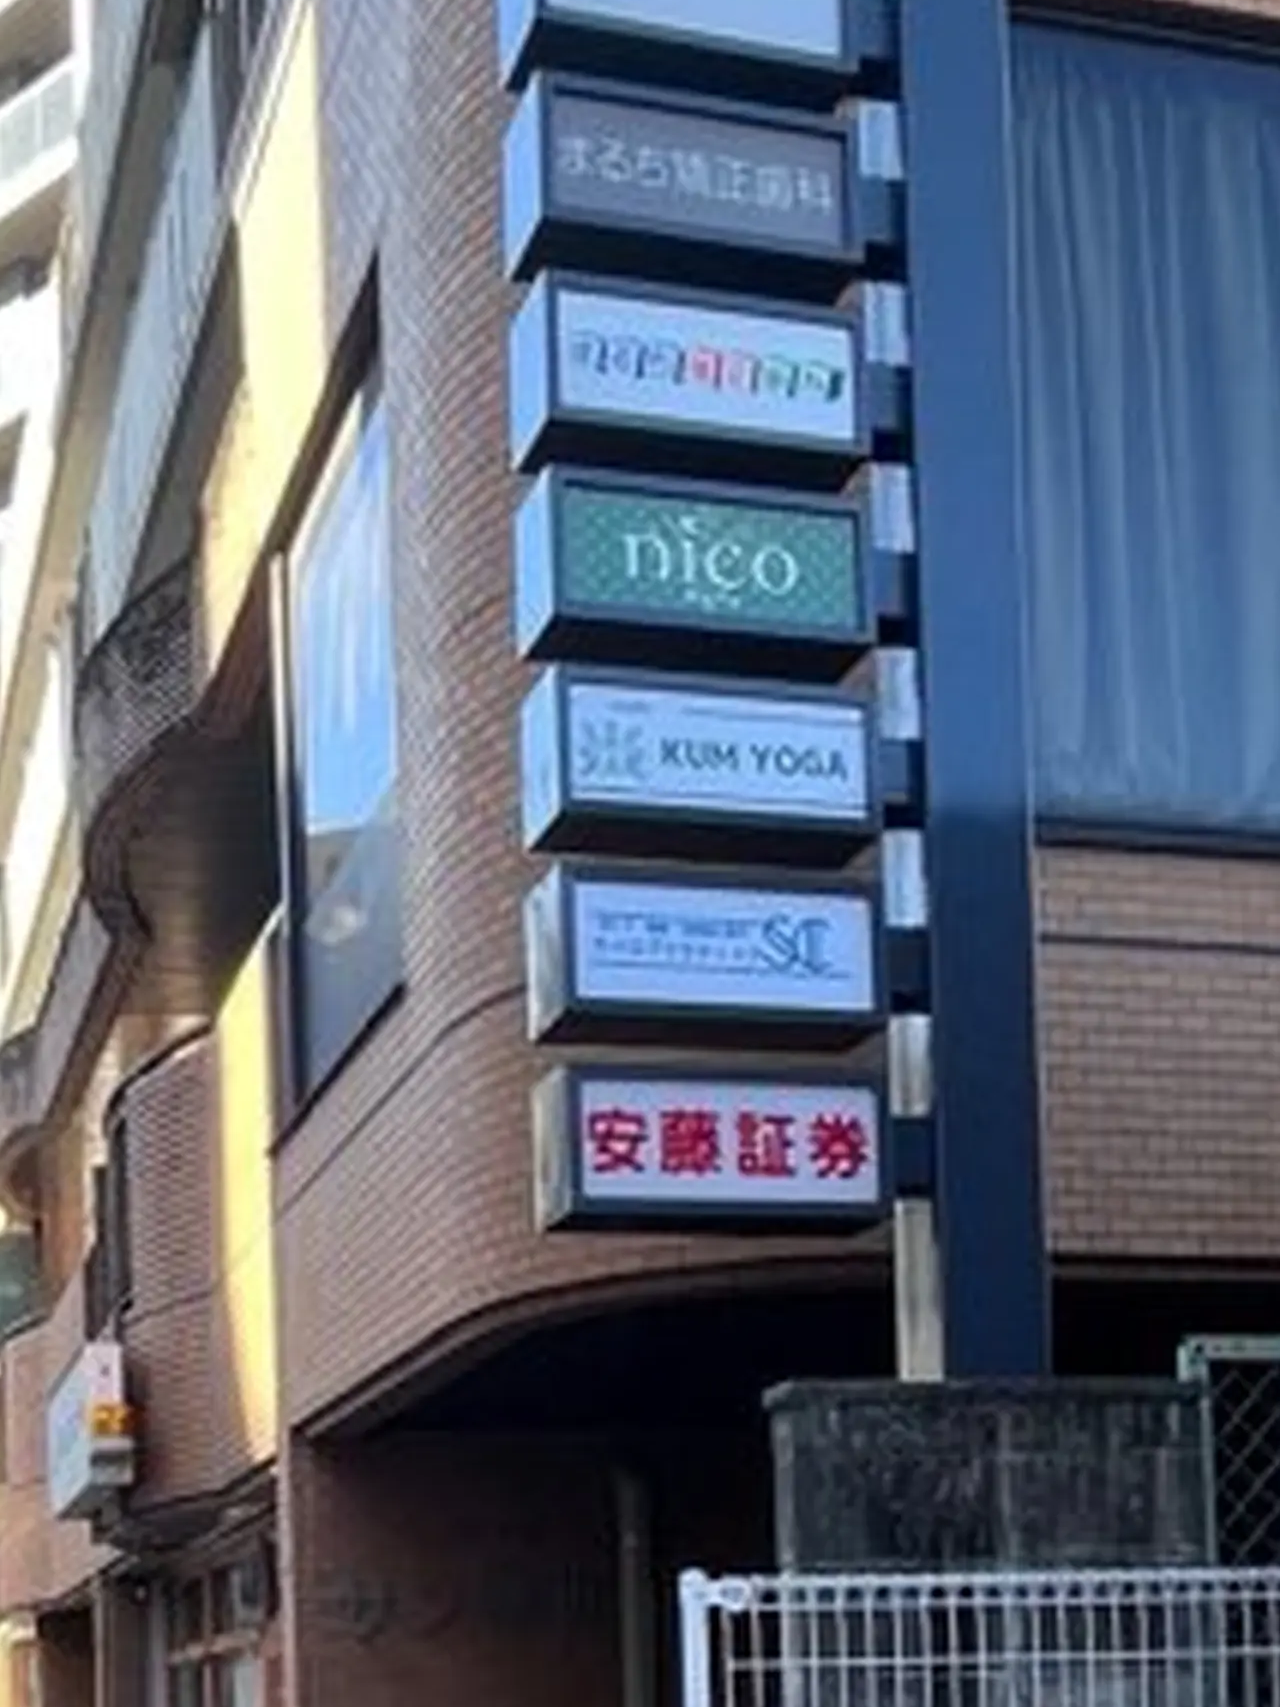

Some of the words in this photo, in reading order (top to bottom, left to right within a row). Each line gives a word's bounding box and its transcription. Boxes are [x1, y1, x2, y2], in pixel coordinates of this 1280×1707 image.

[623, 515, 799, 596] nico
[658, 737, 740, 772] KUM
[749, 742, 849, 783] YOGA
[587, 1108, 869, 1180] 安藤証券
